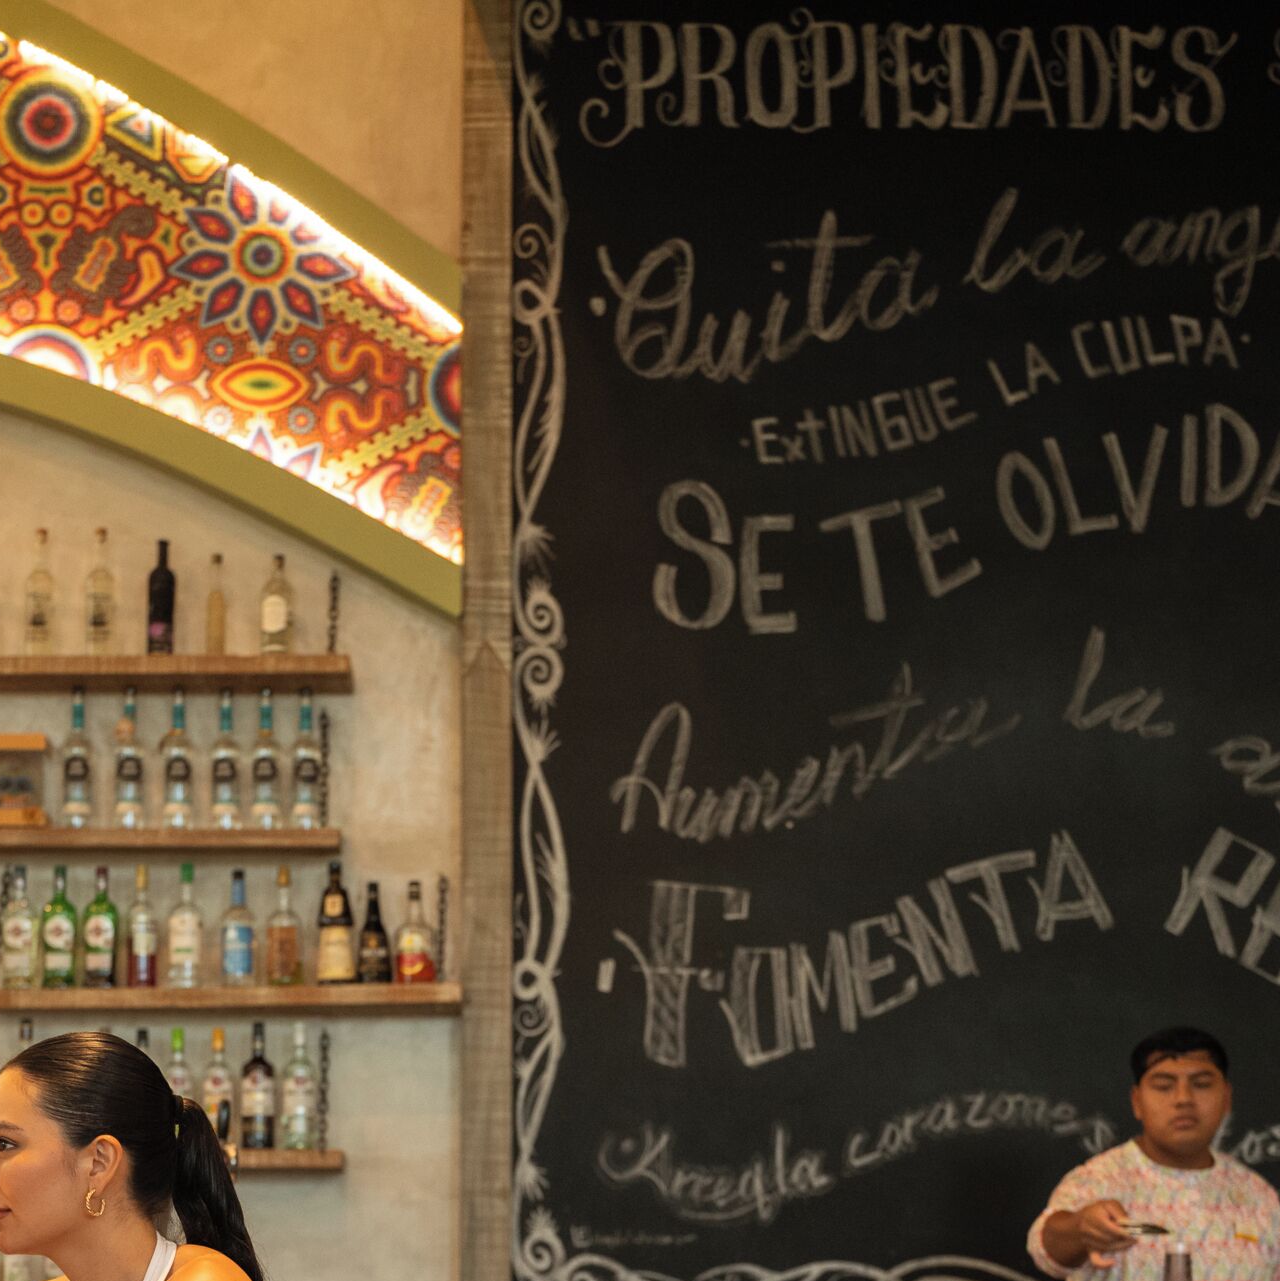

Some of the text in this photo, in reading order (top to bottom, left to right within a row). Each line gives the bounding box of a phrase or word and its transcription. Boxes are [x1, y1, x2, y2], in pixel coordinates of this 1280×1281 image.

[988, 342, 1061, 406] LA
[652, 479, 797, 635] SE
[820, 486, 982, 622] TE
[611, 662, 1021, 842] Aumenta
